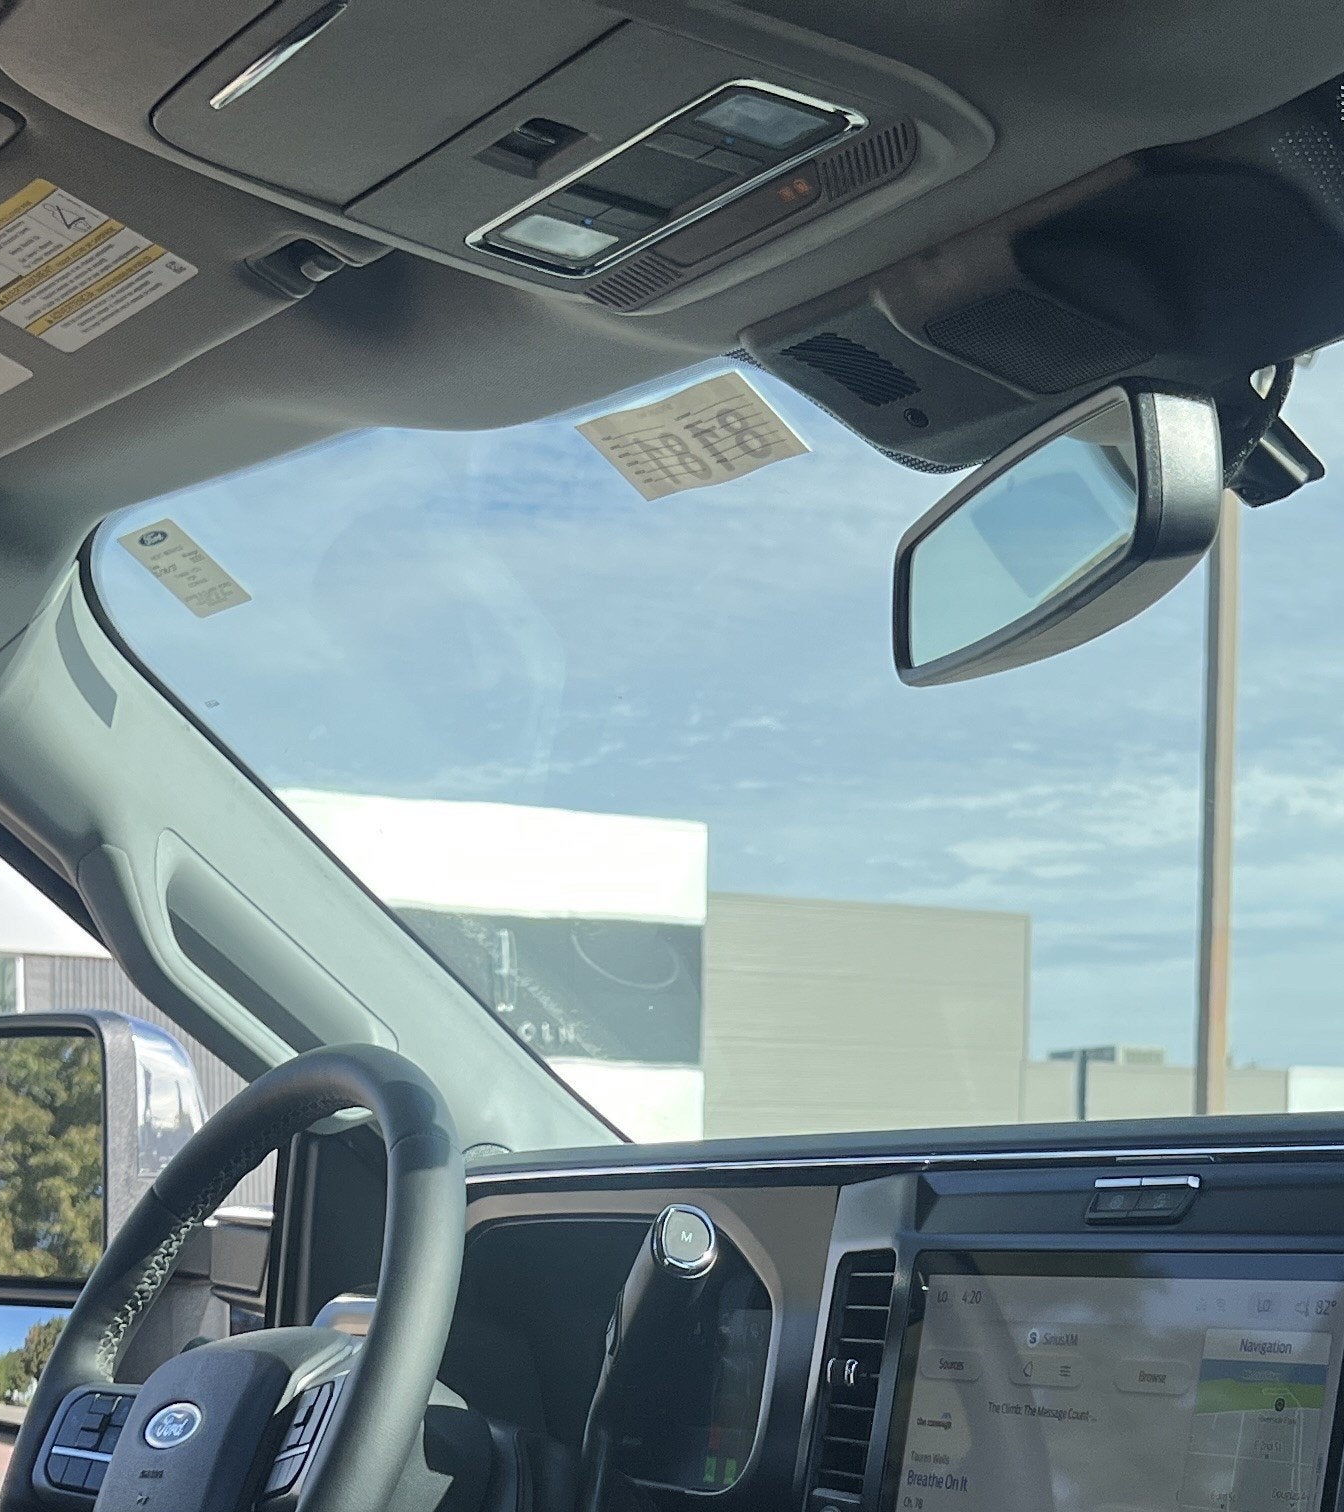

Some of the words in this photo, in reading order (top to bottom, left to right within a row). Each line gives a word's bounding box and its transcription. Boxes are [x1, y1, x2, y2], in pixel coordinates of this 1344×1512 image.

[680, 1230, 694, 1244] M
[1239, 1338, 1293, 1355] Navigation
[1138, 1370, 1167, 1384] Browse
[1024, 1405, 1037, 1417] The
[1038, 1406, 1066, 1421] Message
[156, 1412, 189, 1438] Ford
[907, 1470, 944, 1487] Breathe
[945, 1474, 959, 1489] On
